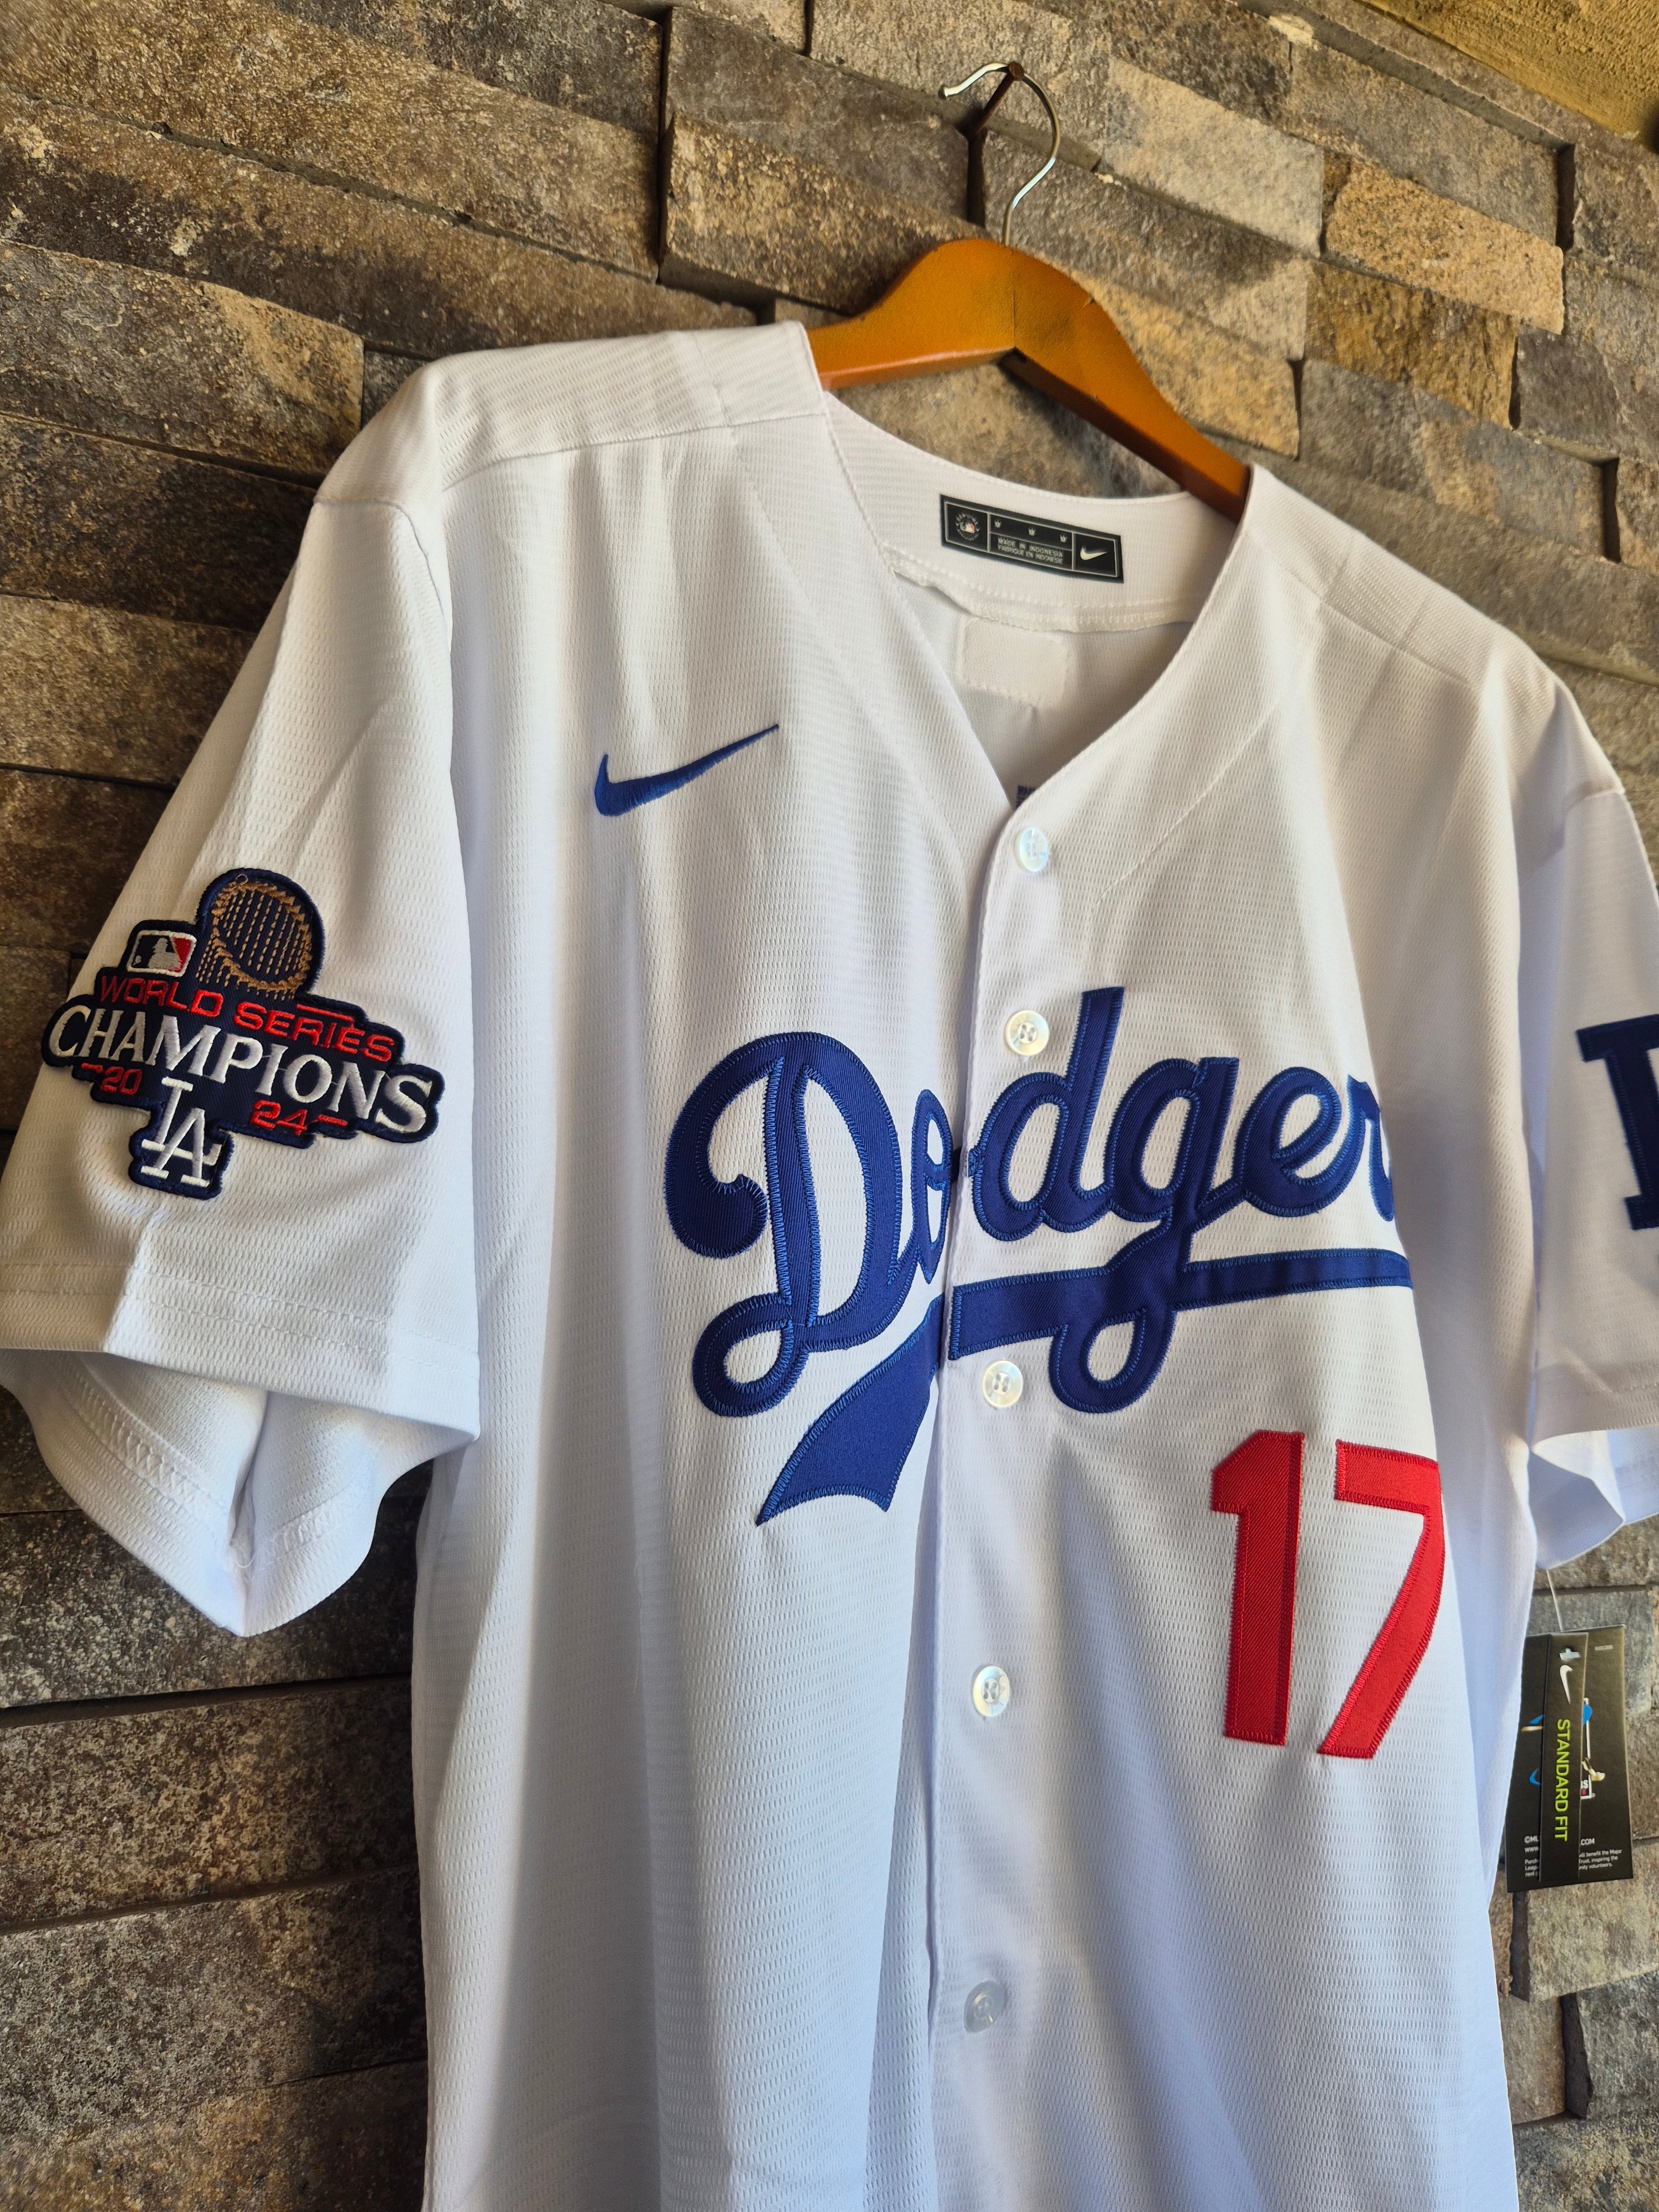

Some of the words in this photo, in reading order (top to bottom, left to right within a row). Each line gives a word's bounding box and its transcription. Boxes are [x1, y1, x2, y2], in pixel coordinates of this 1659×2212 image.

[998, 536, 1016, 547] MADE
[1029, 545, 1063, 558] INDONESIA
[998, 544, 1025, 556] FABRIQUE
[1035, 554, 1063, 564] INDONESIE
[100, 975, 223, 1018] WORLD
[233, 1001, 395, 1063] SERIES
[48, 1005, 434, 1134] CHAMPIONS
[140, 1076, 223, 1188] LA
[1210, 1428, 1446, 1760] 17
[1554, 1718, 1571, 1812] STANDARD
[1554, 1815, 1568, 1841] FIT
